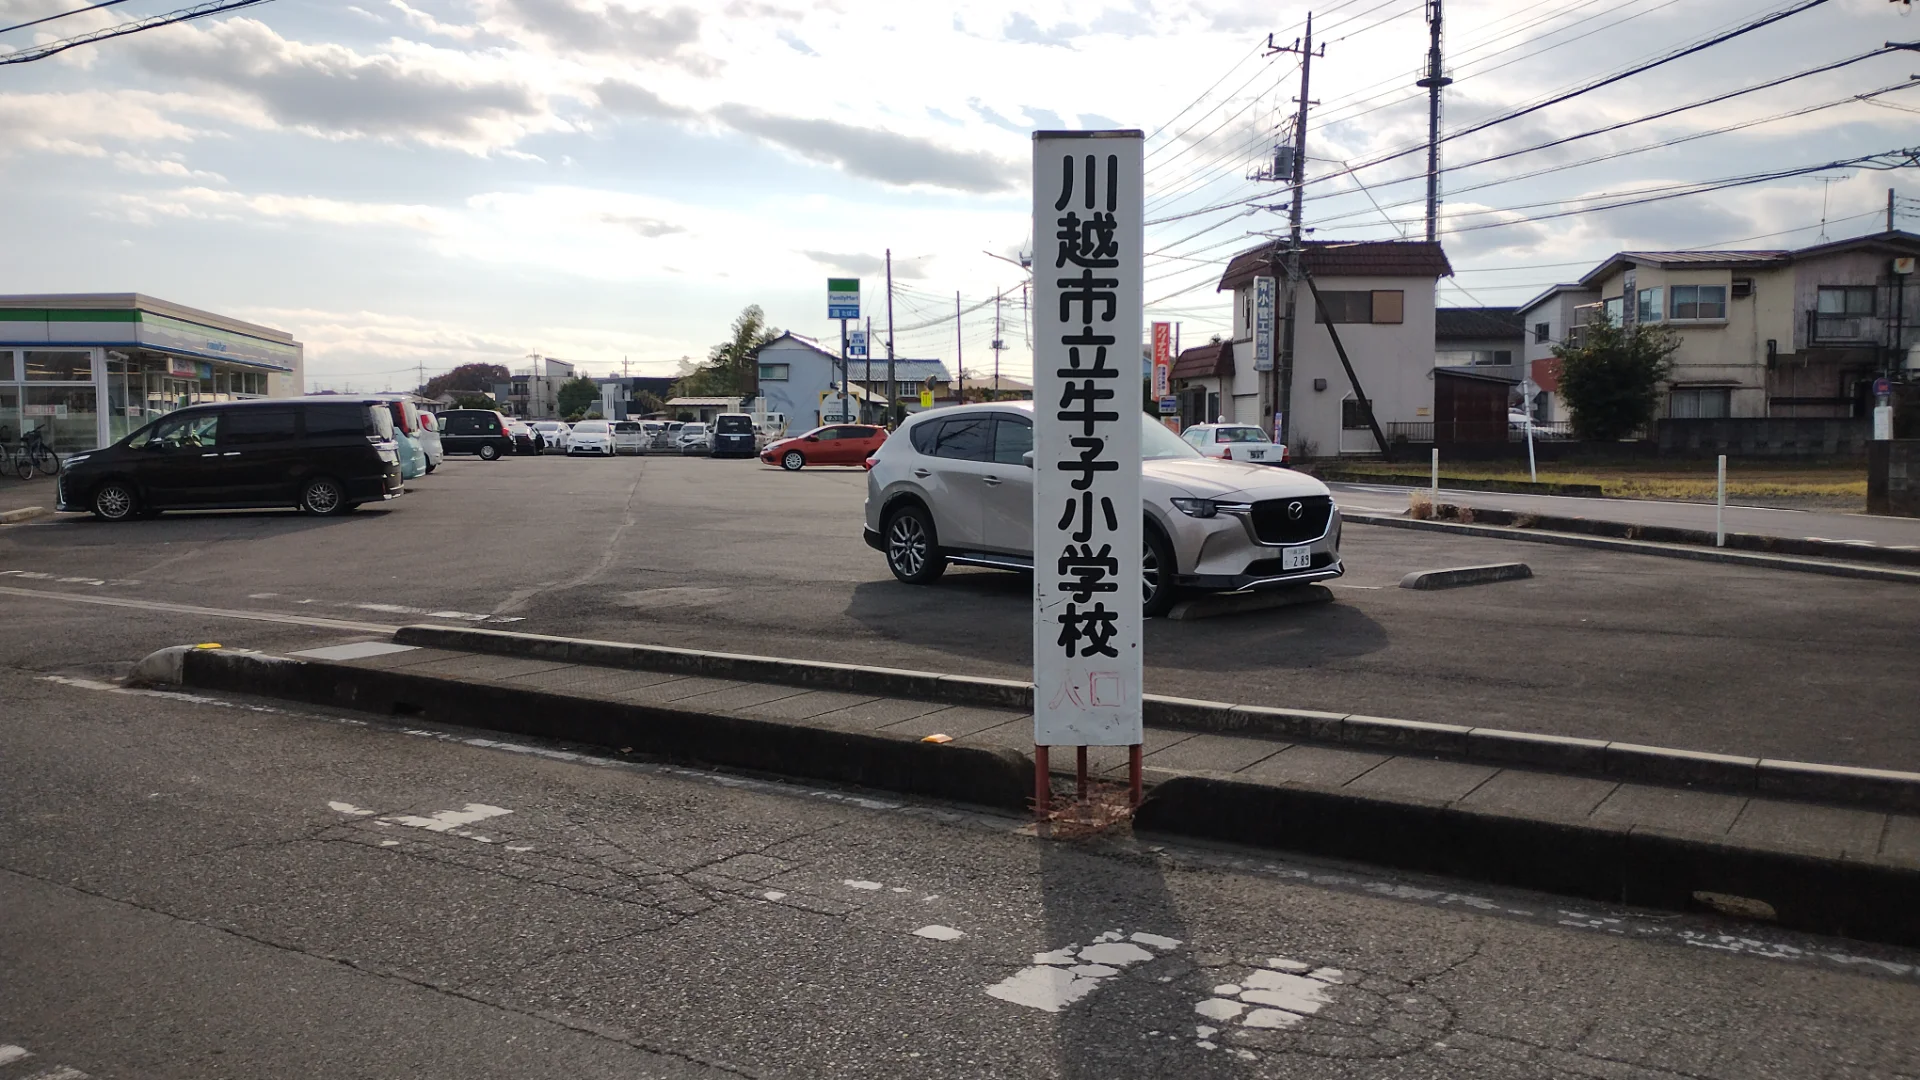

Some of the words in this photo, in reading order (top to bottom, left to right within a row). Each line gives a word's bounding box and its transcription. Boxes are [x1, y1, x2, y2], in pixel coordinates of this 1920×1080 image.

[1055, 154, 1119, 658] 川越市立牛子小学校
